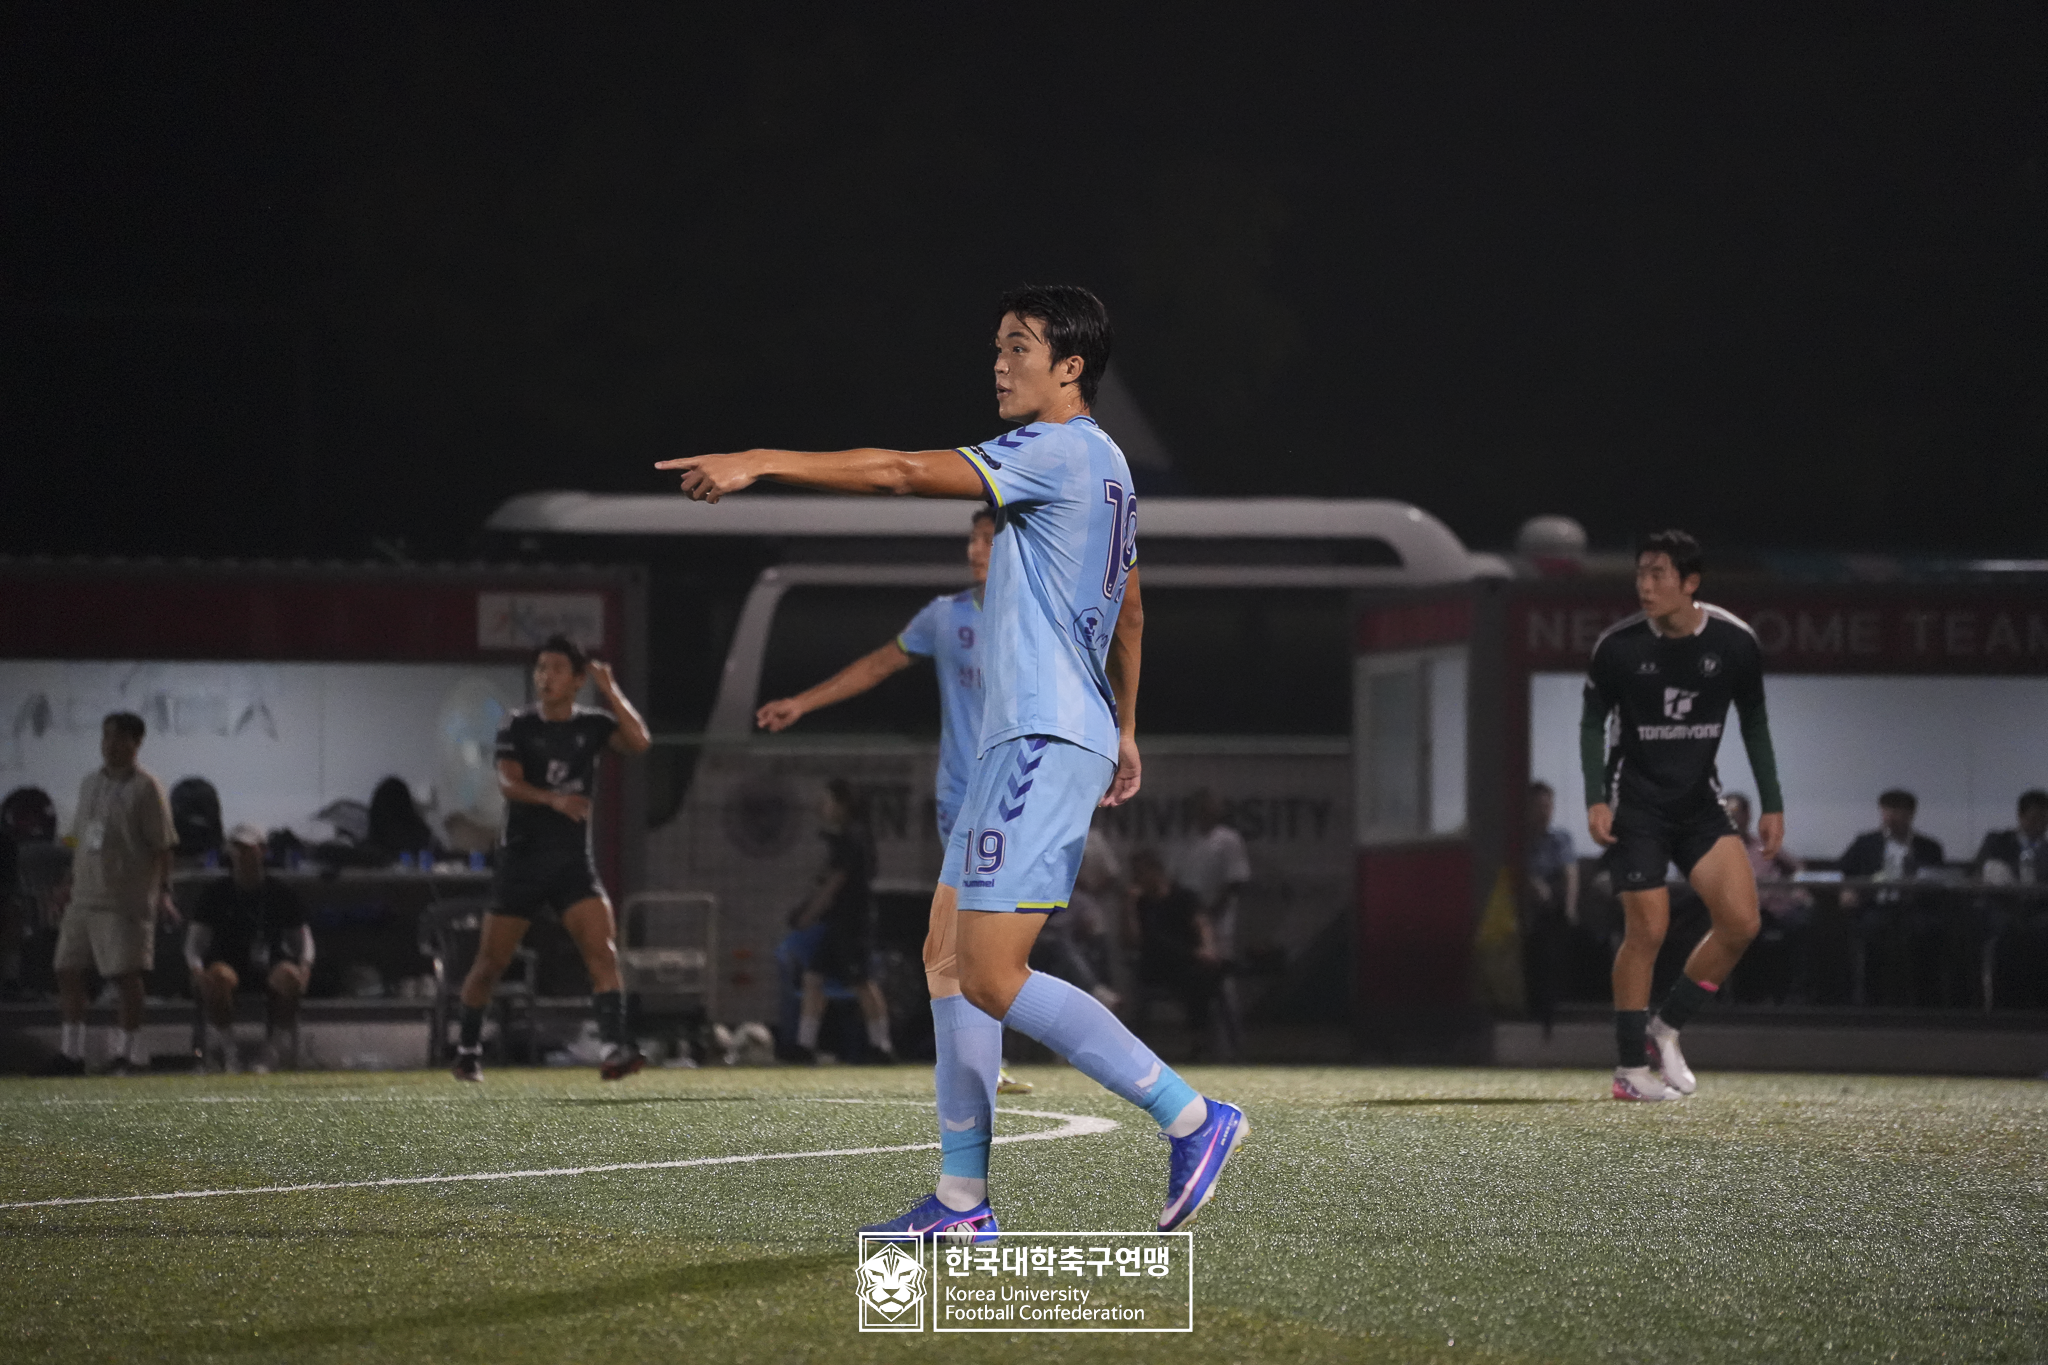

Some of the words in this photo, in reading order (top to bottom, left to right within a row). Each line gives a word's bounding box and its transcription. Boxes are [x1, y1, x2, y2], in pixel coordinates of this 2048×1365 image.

[957, 626, 975, 650] 9
[1526, 609, 1620, 653] NE
[1750, 608, 1881, 656] OME
[963, 828, 1007, 875] 19
